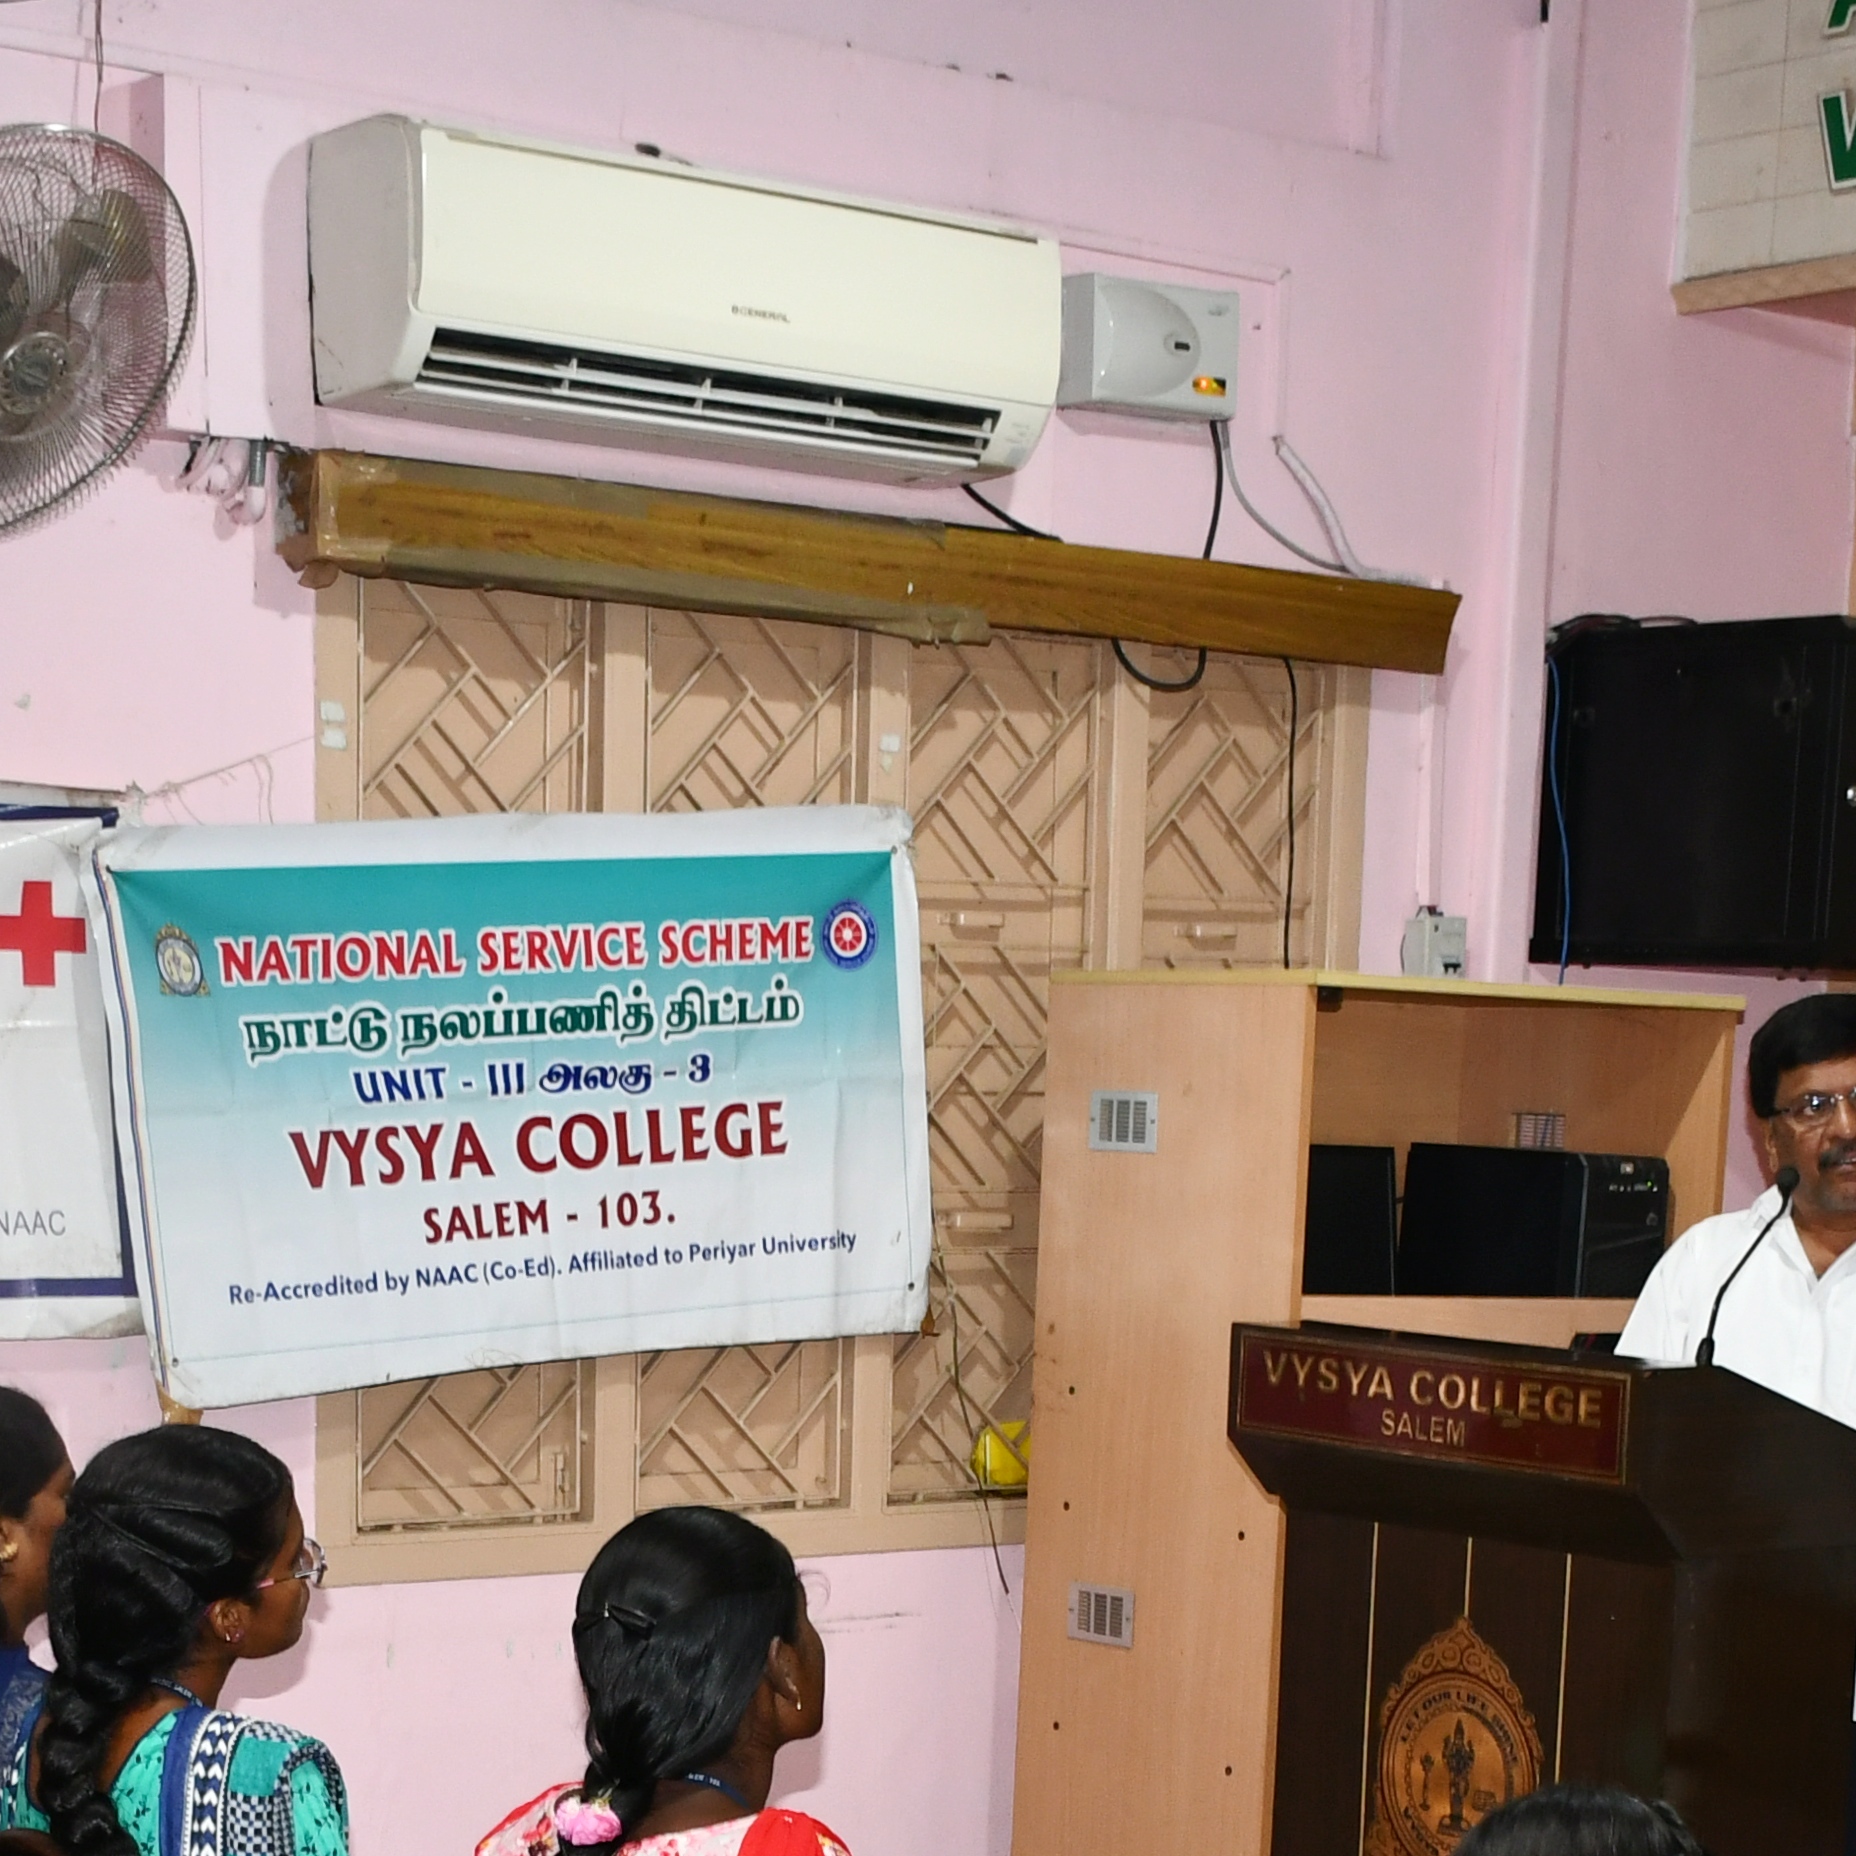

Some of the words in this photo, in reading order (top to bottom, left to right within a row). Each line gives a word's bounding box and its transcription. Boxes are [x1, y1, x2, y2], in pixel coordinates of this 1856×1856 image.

[218, 932, 464, 984] NATIONAL
[479, 926, 646, 972] SERVICE
[660, 919, 812, 965] SCHEME
[243, 1006, 388, 1063] நாட்டு
[400, 984, 655, 1057] நலப்பணித்
[665, 978, 800, 1041] திட்டம்
[352, 1067, 446, 1104] UNIT
[487, 1062, 525, 1097] III
[539, 1062, 651, 1095] அலகு
[689, 1053, 711, 1083] 3
[287, 1121, 496, 1190] VYSYA
[516, 1100, 789, 1175] COLLEGE
[423, 1198, 550, 1245] SALEM
[597, 1190, 676, 1230] 103.
[228, 1271, 378, 1306] Re-Accredited
[385, 1270, 410, 1296] by
[415, 1263, 479, 1289] NAAC
[569, 1246, 658, 1275] Affiliated
[664, 1245, 683, 1265] to
[689, 1239, 757, 1264] Periyar
[761, 1229, 857, 1257] University
[1262, 1350, 1395, 1401] VYSYA
[1408, 1369, 1603, 1429] COLLEGE
[1380, 1408, 1466, 1447] SALEM
